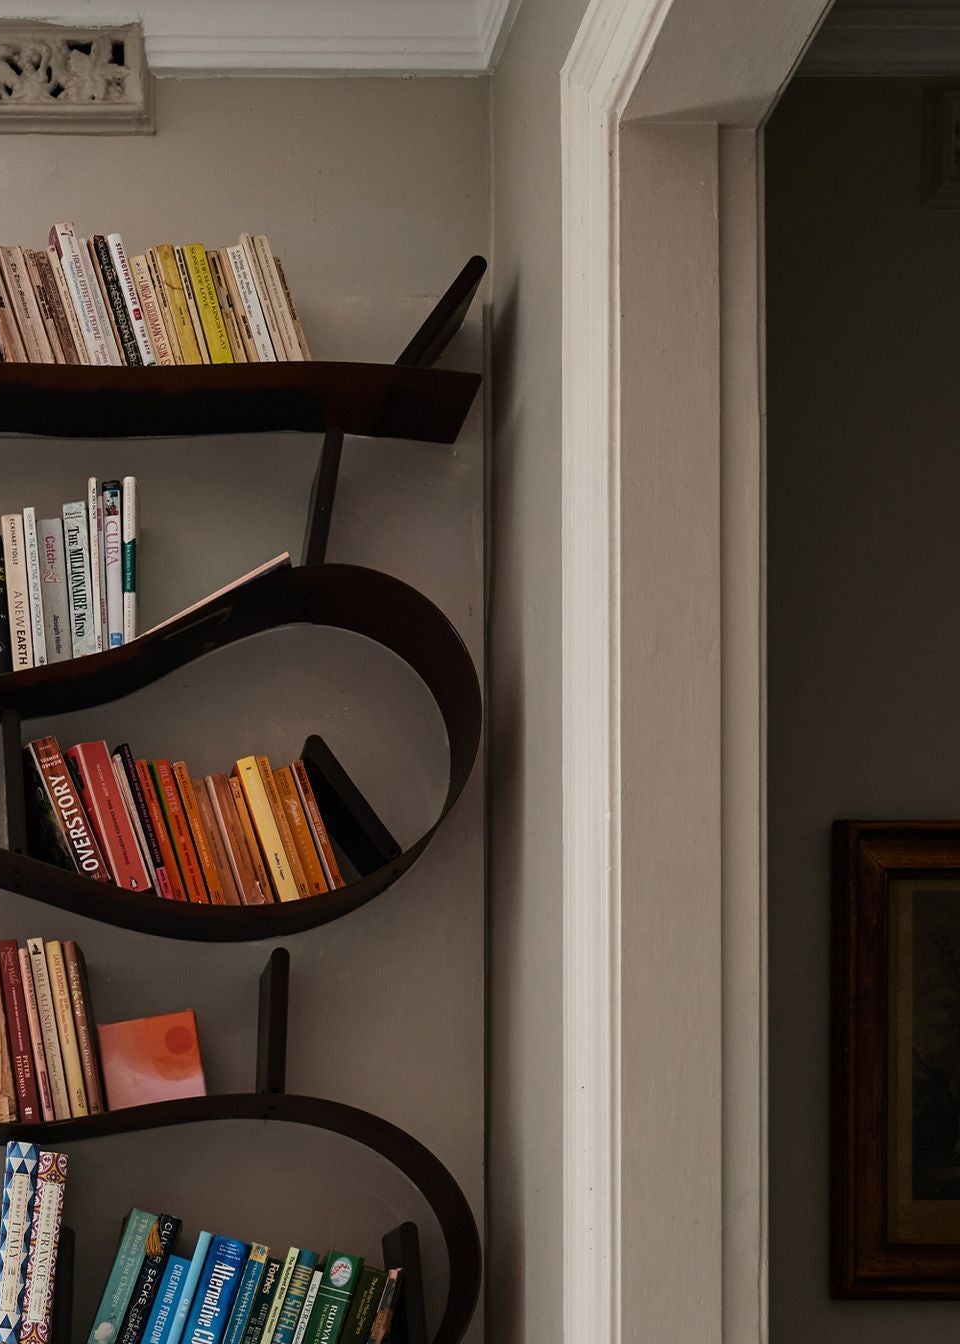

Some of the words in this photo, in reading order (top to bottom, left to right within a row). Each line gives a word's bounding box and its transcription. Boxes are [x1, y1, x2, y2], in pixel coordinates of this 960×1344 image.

[60, 229, 73, 239] 7
[115, 242, 137, 305] STRENGTHSFINDER
[189, 246, 200, 274] SONGS
[198, 258, 207, 273] THE
[137, 279, 152, 300] LINDA
[196, 275, 203, 284] OF
[202, 275, 215, 305] MAMBO
[71, 254, 84, 279] HIGHLY
[78, 279, 94, 315] EFFECTIVE
[88, 315, 101, 341] PEOPLE
[199, 287, 209, 309] LOVE
[143, 301, 163, 342] GOODMAN'S
[210, 305, 221, 329] KINGS
[138, 326, 146, 337] TOM
[142, 339, 151, 354] RATH
[155, 342, 168, 358] SUN
[217, 329, 227, 350] PLAY
[67, 526, 79, 545] THE
[105, 520, 118, 565] CUBA
[69, 548, 87, 609] MILLIONAIRE
[13, 590, 22, 598] A
[32, 593, 38, 601] OF
[14, 600, 24, 627] NEW
[33, 602, 41, 637] ASTROLOGY
[51, 614, 60, 635] Joseph
[73, 612, 86, 636] MIND
[16, 629, 27, 664] EARTH
[53, 636, 62, 654] Heller
[40, 753, 59, 764] POWERS
[41, 758, 62, 769] RICHARD
[158, 764, 171, 784] BILL
[163, 785, 178, 813] GATES
[47, 771, 100, 873] OVERSTORY
[52, 953, 60, 965] IAN
[34, 959, 45, 989] ISABEL
[54, 966, 65, 995] FLEMING
[39, 992, 52, 1032] ALLENDE
[15, 1055, 26, 1097] FITZSIMONS
[22, 1054, 30, 1077] PETER
[136, 1217, 148, 1234] The
[8, 1222, 20, 1259] ITALY
[129, 1234, 142, 1255] Brain
[151, 1221, 173, 1263] OLIVR
[35, 1231, 50, 1281] FRANCE
[122, 1256, 135, 1274] That
[287, 1256, 295, 1265] The
[137, 1268, 156, 1306] SACKS
[162, 1263, 183, 1303] CREATING
[261, 1262, 278, 1295] Forbes
[281, 1266, 292, 1285] Nutrient
[288, 1264, 312, 1296] DAWN
[111, 1275, 128, 1308] Changes
[195, 1259, 236, 1329] Alternative
[276, 1286, 285, 1300] Bible
[149, 1304, 170, 1344] FREEDOM
[276, 1297, 302, 1333] STEEL
